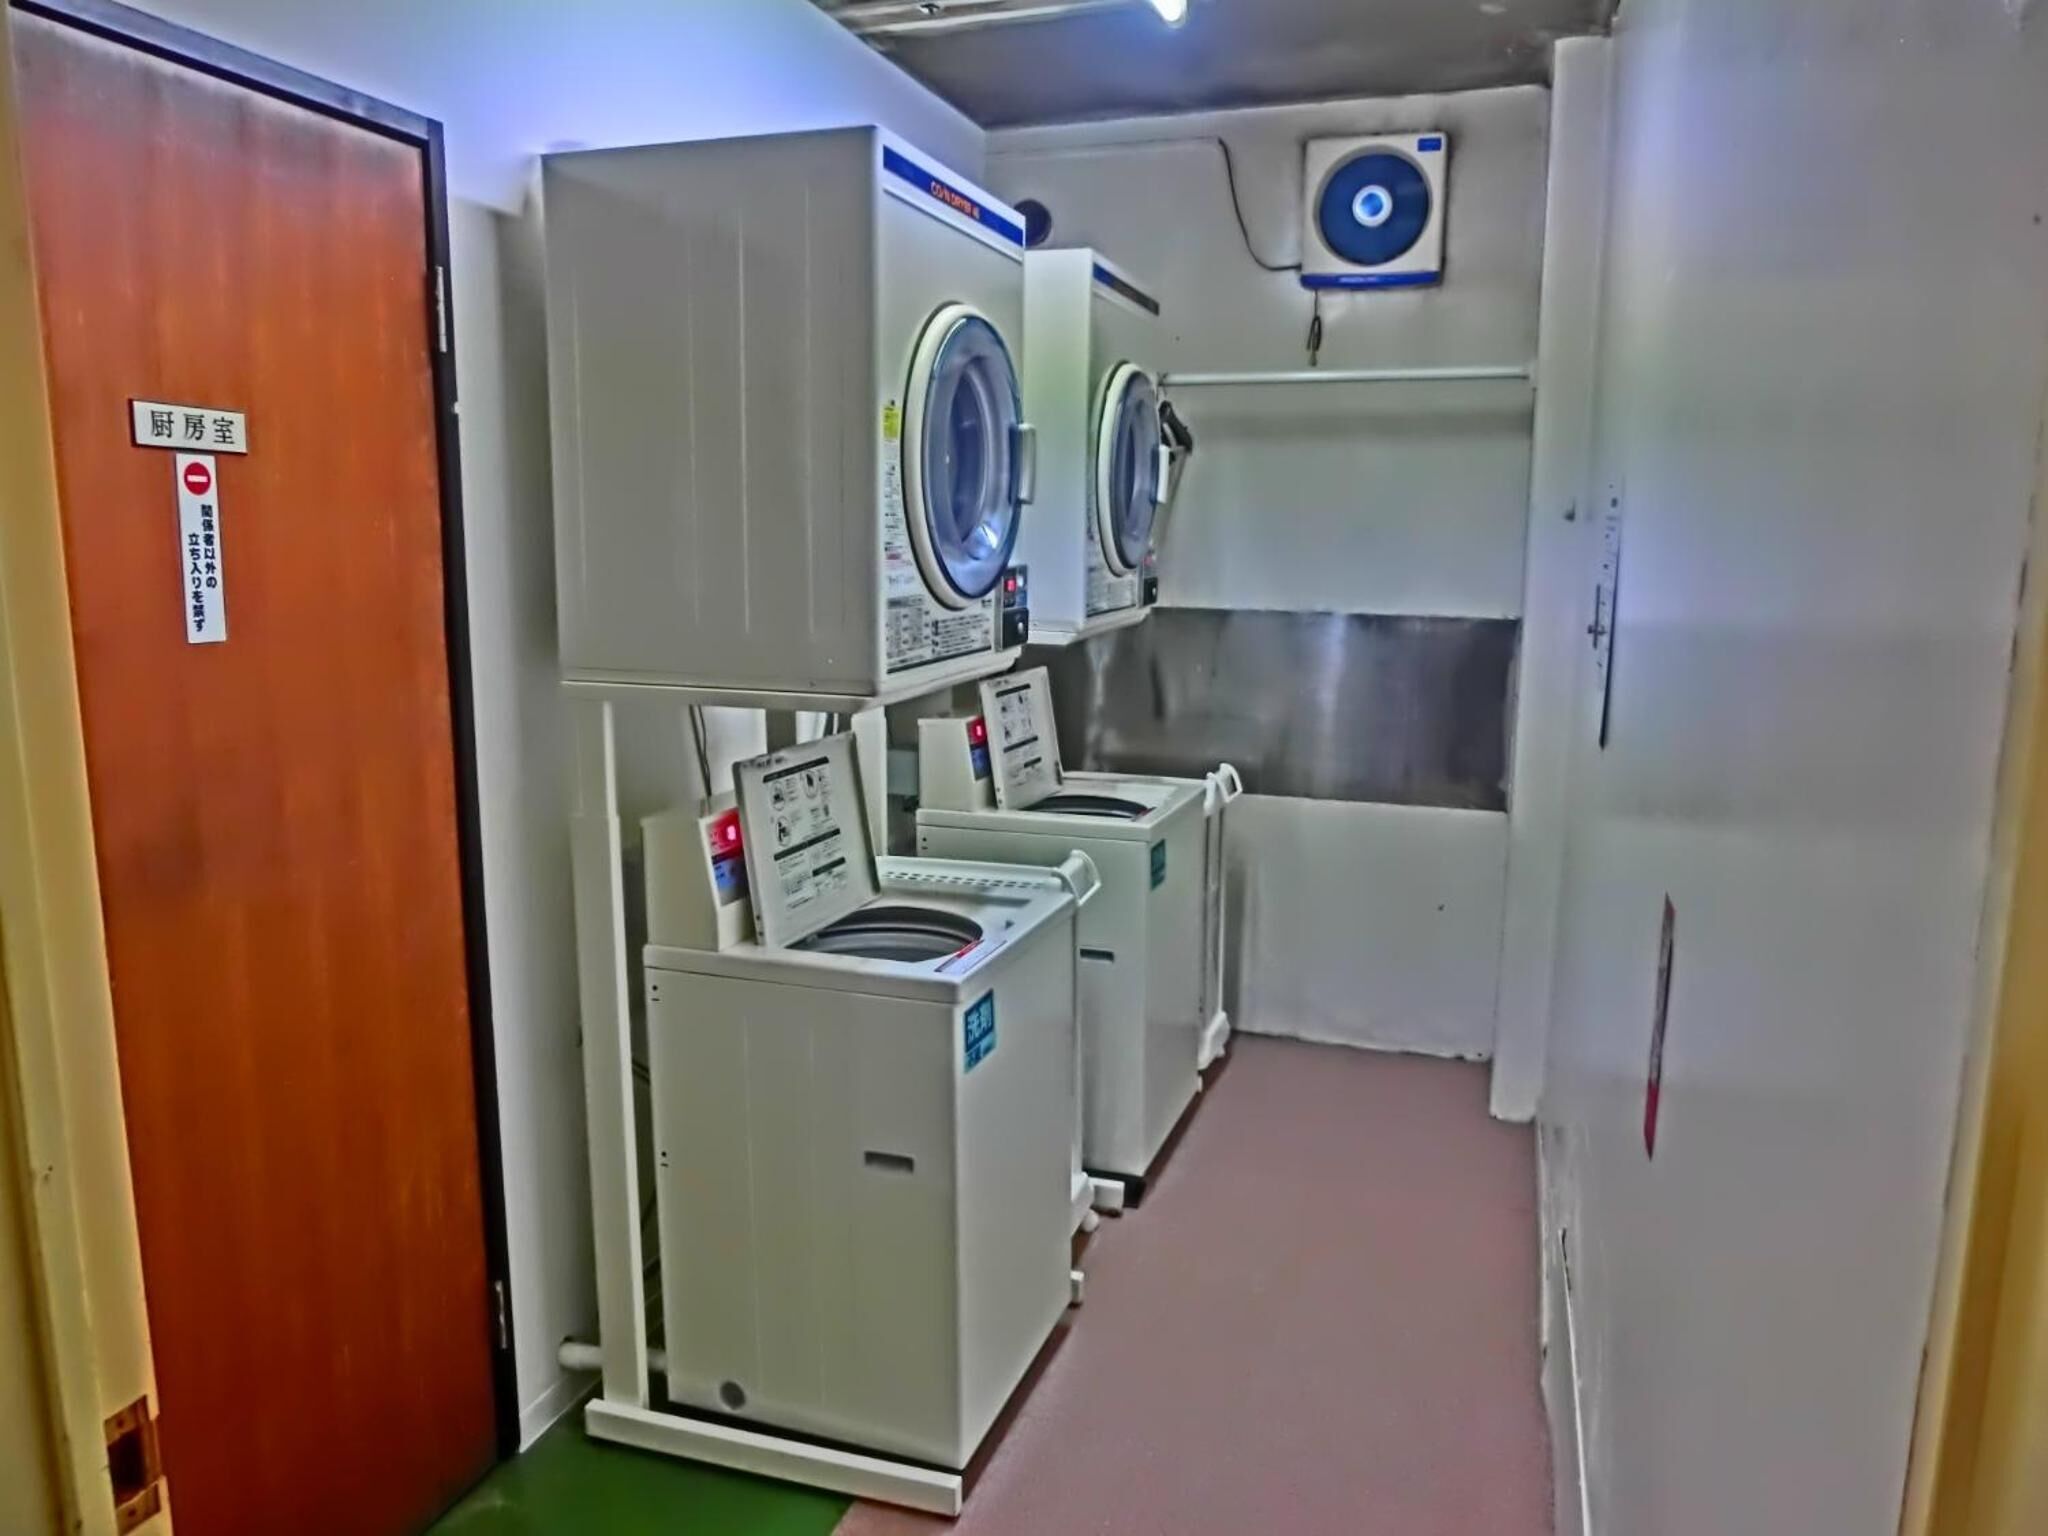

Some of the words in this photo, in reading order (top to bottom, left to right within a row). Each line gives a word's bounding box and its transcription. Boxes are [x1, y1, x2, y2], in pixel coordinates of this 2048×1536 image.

[150, 410, 235, 444] 厨房室
[188, 533, 205, 632] 立ち入りを禁ず
[201, 505, 217, 588] 関係者以外の
